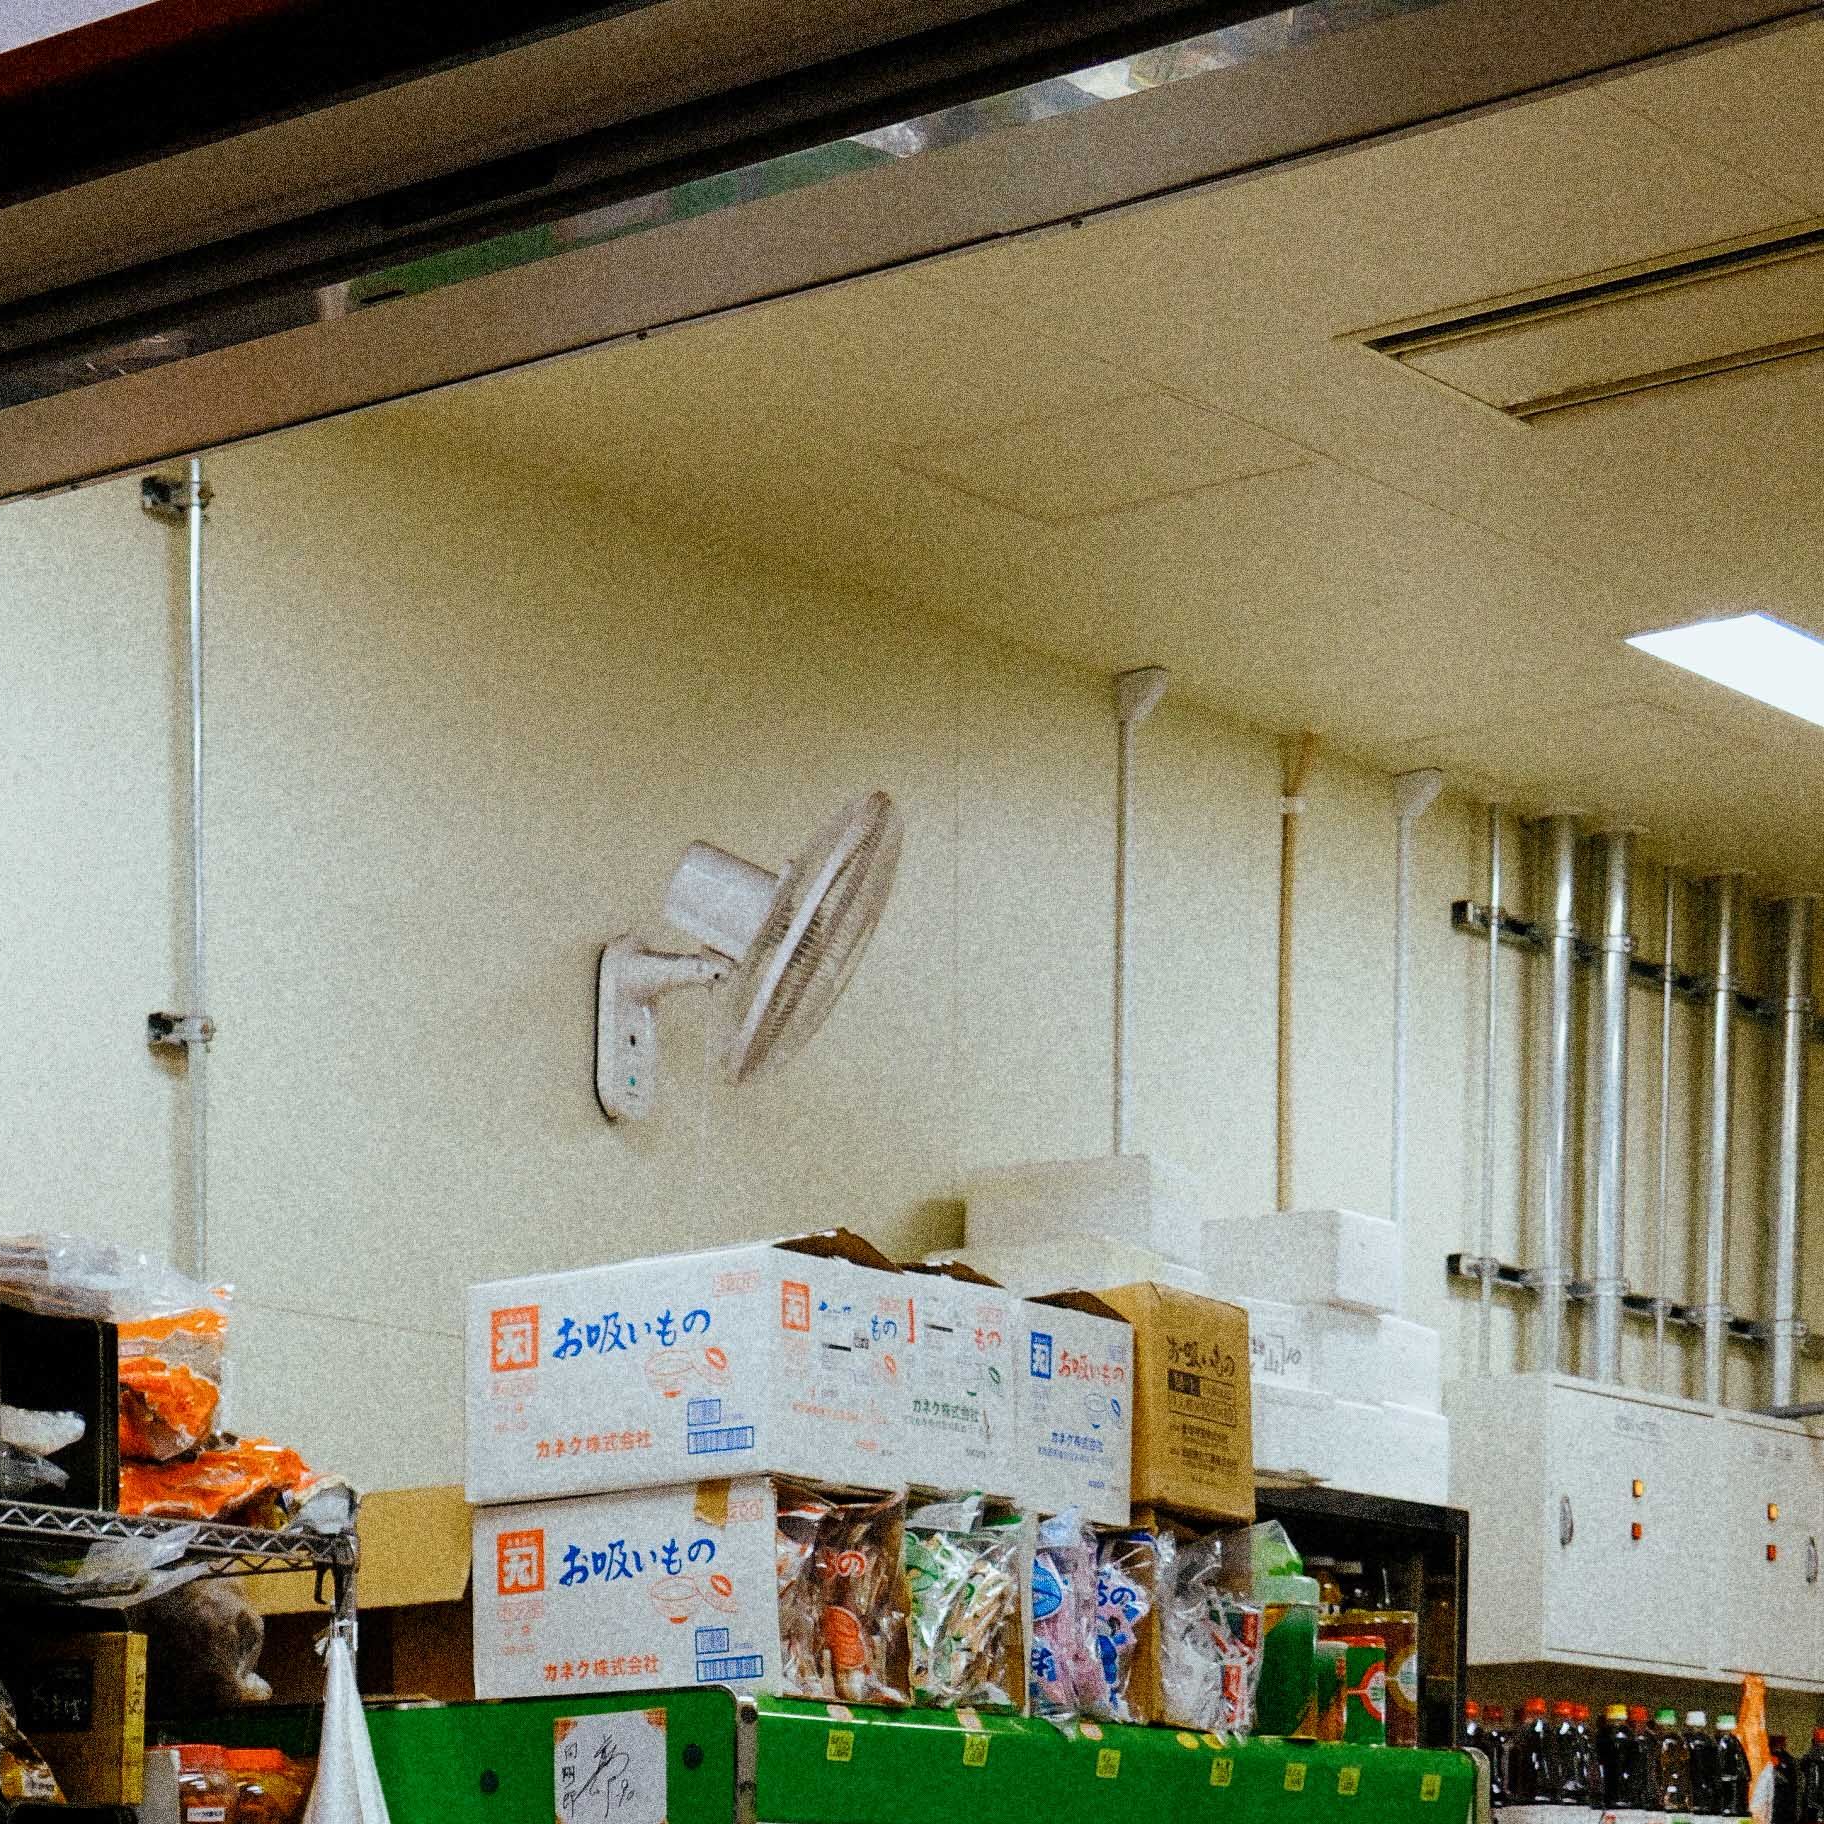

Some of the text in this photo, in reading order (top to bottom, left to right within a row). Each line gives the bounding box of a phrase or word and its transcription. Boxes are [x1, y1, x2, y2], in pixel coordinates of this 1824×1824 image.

[552, 1309, 712, 1360] お吸いもの
[559, 1537, 717, 1587] お吸いもの
